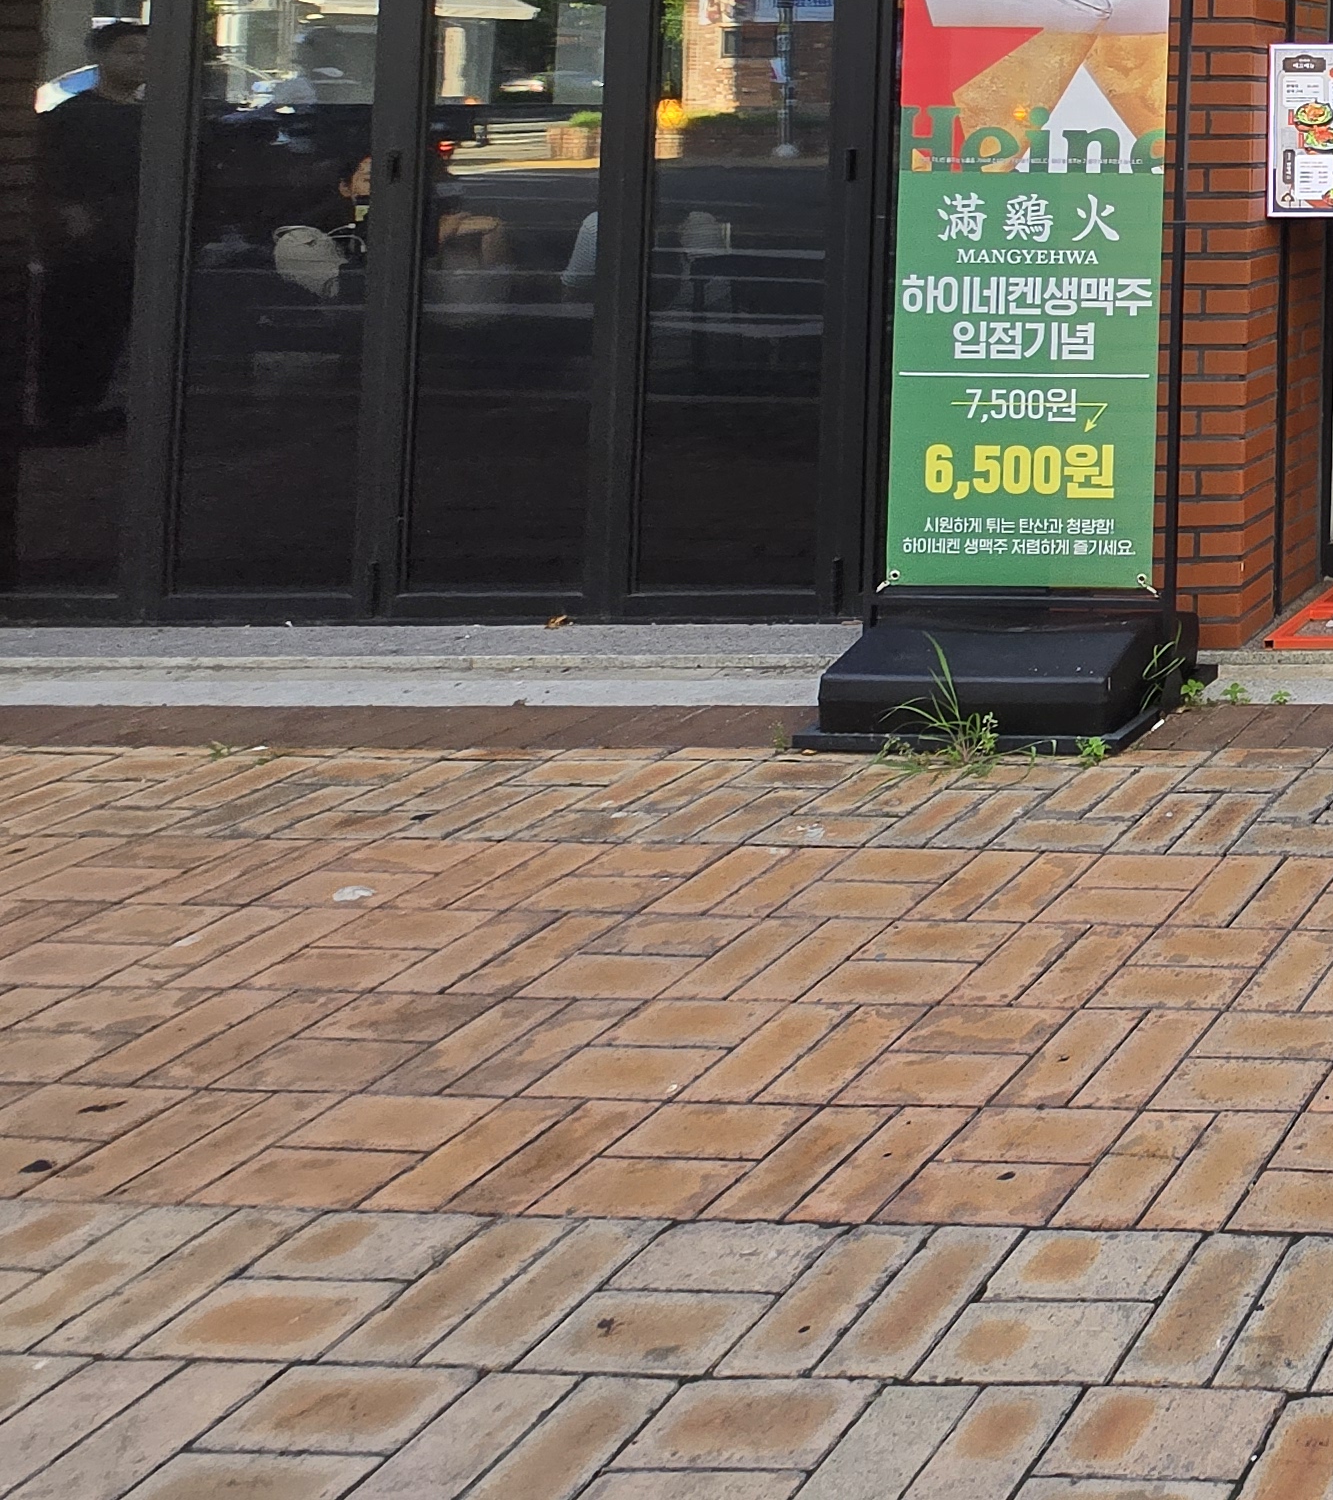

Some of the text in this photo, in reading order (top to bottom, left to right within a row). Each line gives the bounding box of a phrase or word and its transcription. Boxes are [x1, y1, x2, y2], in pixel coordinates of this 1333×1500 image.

[956, 248, 1099, 265] MANGYEHWA
[901, 275, 1153, 317] 하이네켄생맥주
[952, 322, 1096, 361] 입점기념
[964, 388, 1078, 424] 7,500원
[924, 443, 1115, 500] 6,500원
[924, 516, 1115, 536] 시원하게 튀는 탄산과 청량함!
[902, 537, 1137, 557] 하이네켄 생맥주 저렴하게 즐기세요.
